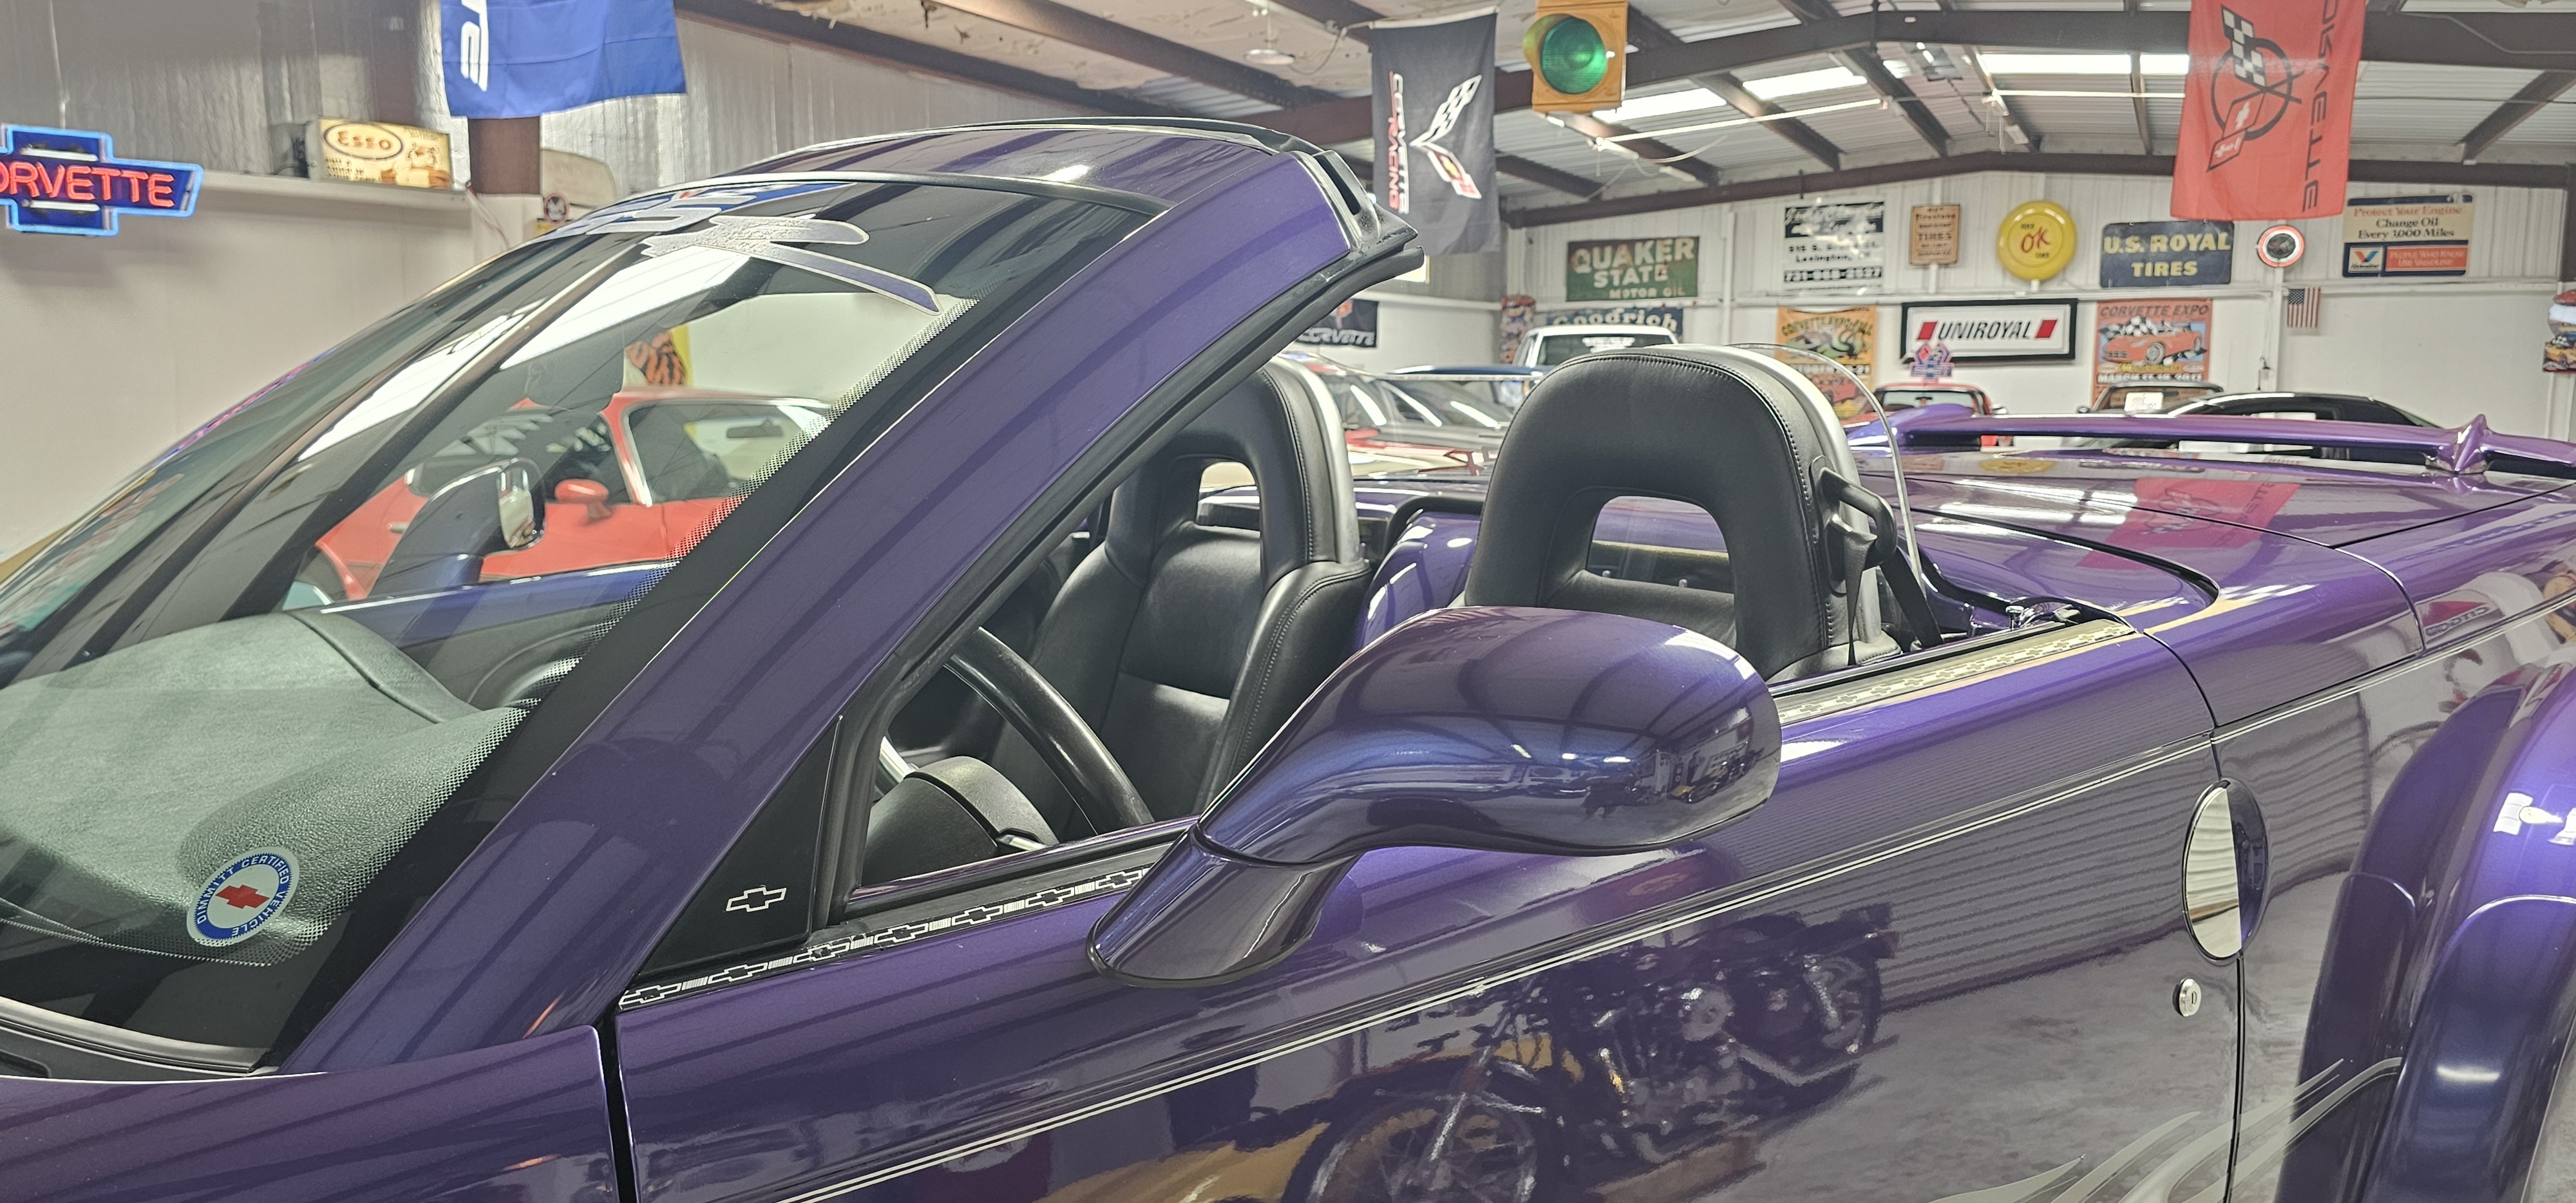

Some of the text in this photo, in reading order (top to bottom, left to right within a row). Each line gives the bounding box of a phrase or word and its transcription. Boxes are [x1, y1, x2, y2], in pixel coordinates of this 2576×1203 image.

[1392, 73, 1409, 214] CORVETTE
[1388, 116, 1400, 210] RACING
[2354, 205, 2462, 217] Protect Your Engine
[2376, 217, 2439, 228] Change Oil
[2021, 225, 2051, 254] OK
[2103, 231, 2231, 254] U.S. ROYAL
[2358, 229, 2389, 240] Every
[2423, 228, 2454, 237] Miles
[1573, 238, 1695, 274] QUAKER
[1593, 263, 1669, 289] STATE
[2131, 261, 2198, 278] TIRES
[1609, 287, 1687, 299] MOTOR OIL
[2099, 304, 2209, 317] CORVETTE EXPO
[1938, 321, 2032, 340] UNIROYAL
[196, 855, 290, 937] DIMMITT CERTIFIED VEHICLE
